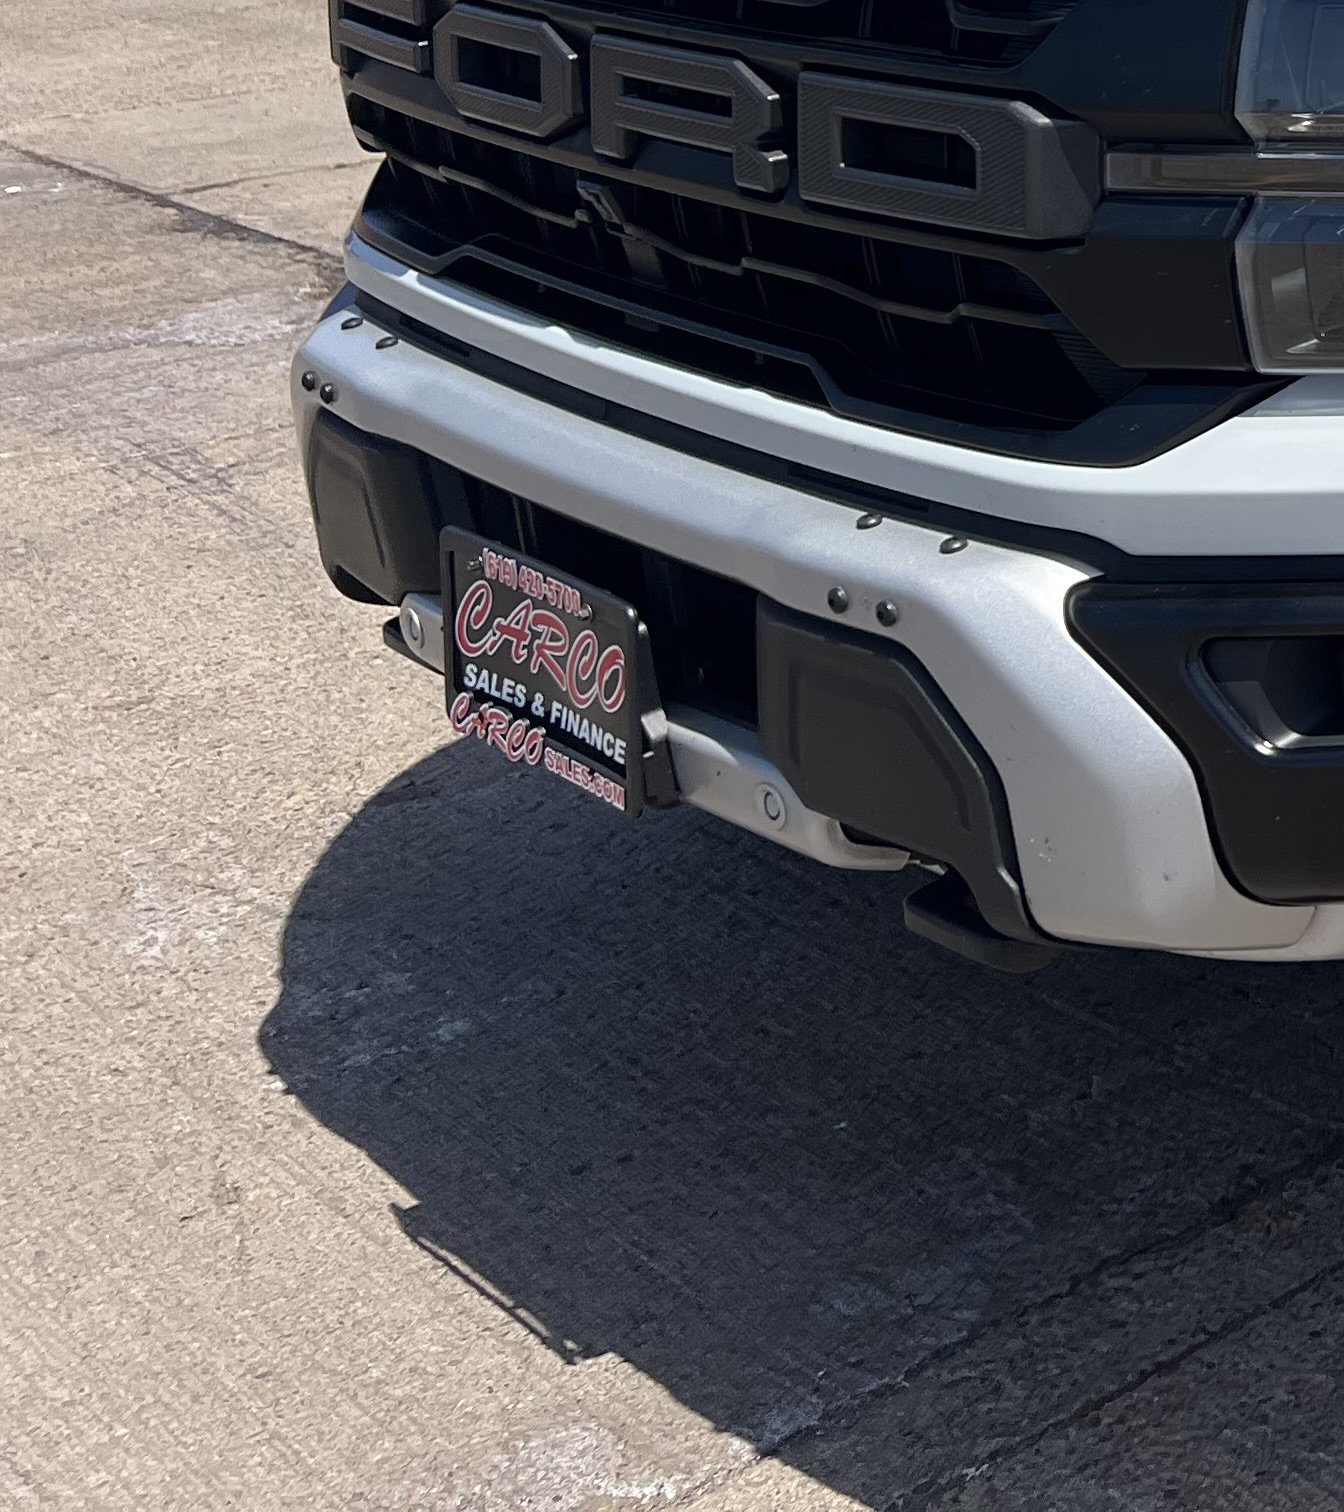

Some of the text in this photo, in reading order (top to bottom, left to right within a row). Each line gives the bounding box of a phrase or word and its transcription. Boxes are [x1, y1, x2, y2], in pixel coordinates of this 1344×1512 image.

[482, 547, 518, 591] (619)
[455, 579, 626, 713] CARCO
[450, 691, 546, 765] CARCO
[463, 663, 628, 765] SALES & FINANCE
